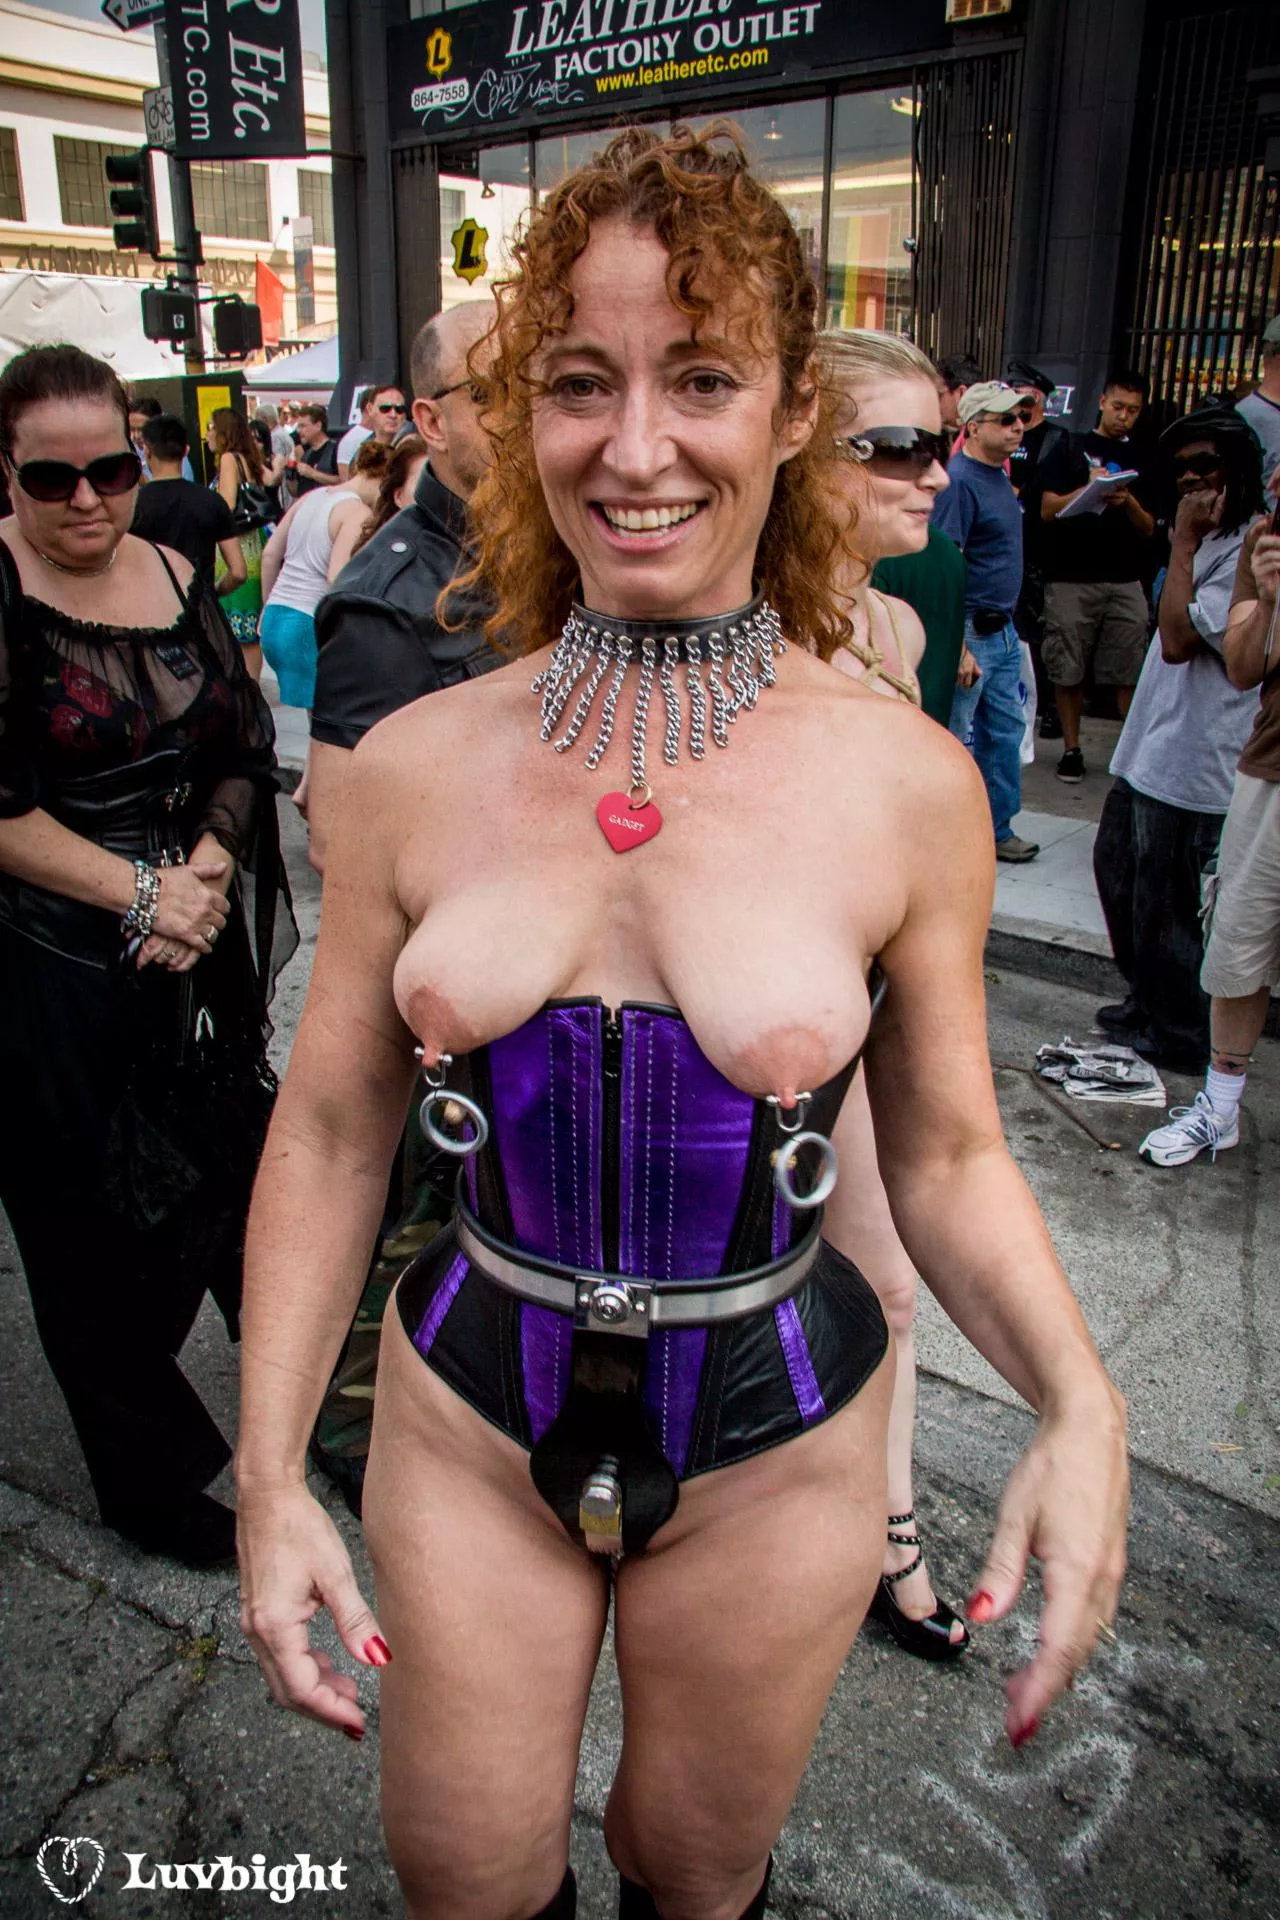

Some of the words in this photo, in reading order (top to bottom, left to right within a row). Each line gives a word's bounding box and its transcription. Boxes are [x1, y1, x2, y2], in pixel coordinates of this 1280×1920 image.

[554, 30, 682, 81] FACTORY
[693, 2, 822, 53] OUTLET
[228, 31, 287, 138] Etc.
[595, 47, 769, 93] www.leatheretc.com
[413, 83, 466, 108] 864-7558
[459, 229, 481, 270] L
[608, 815, 645, 832] GADGET
